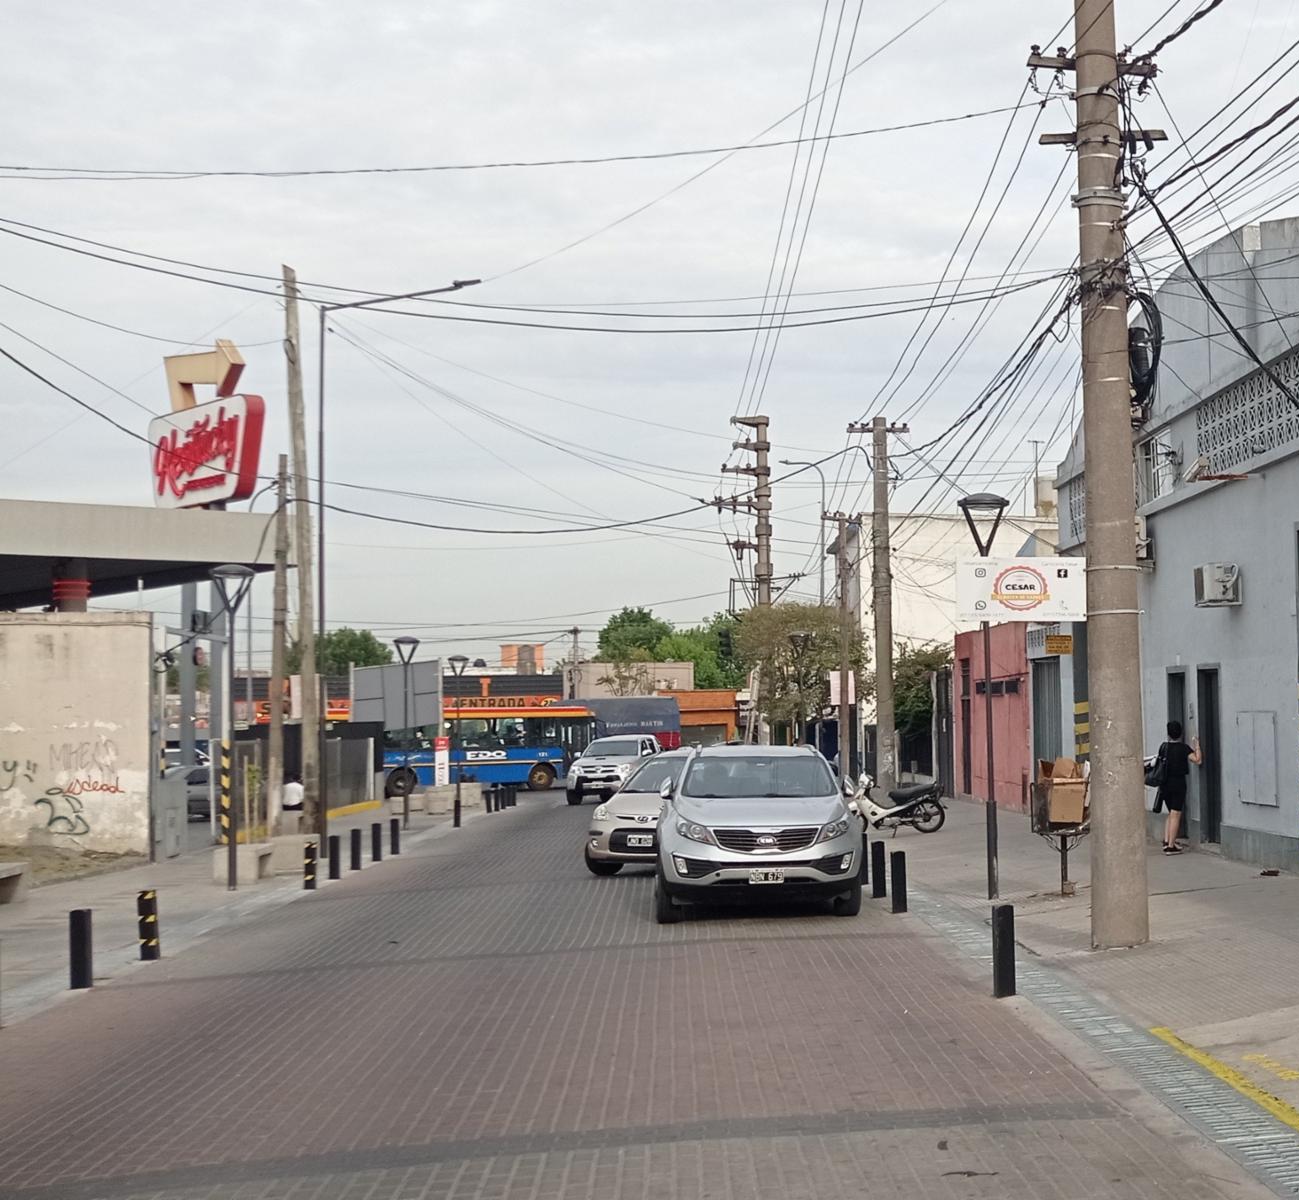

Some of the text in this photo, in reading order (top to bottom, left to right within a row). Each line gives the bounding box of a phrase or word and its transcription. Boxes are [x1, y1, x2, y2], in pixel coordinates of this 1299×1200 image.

[154, 406, 239, 500] Kentucky
[460, 697, 526, 708] ENTRADA
[768, 872, 784, 881] 679
